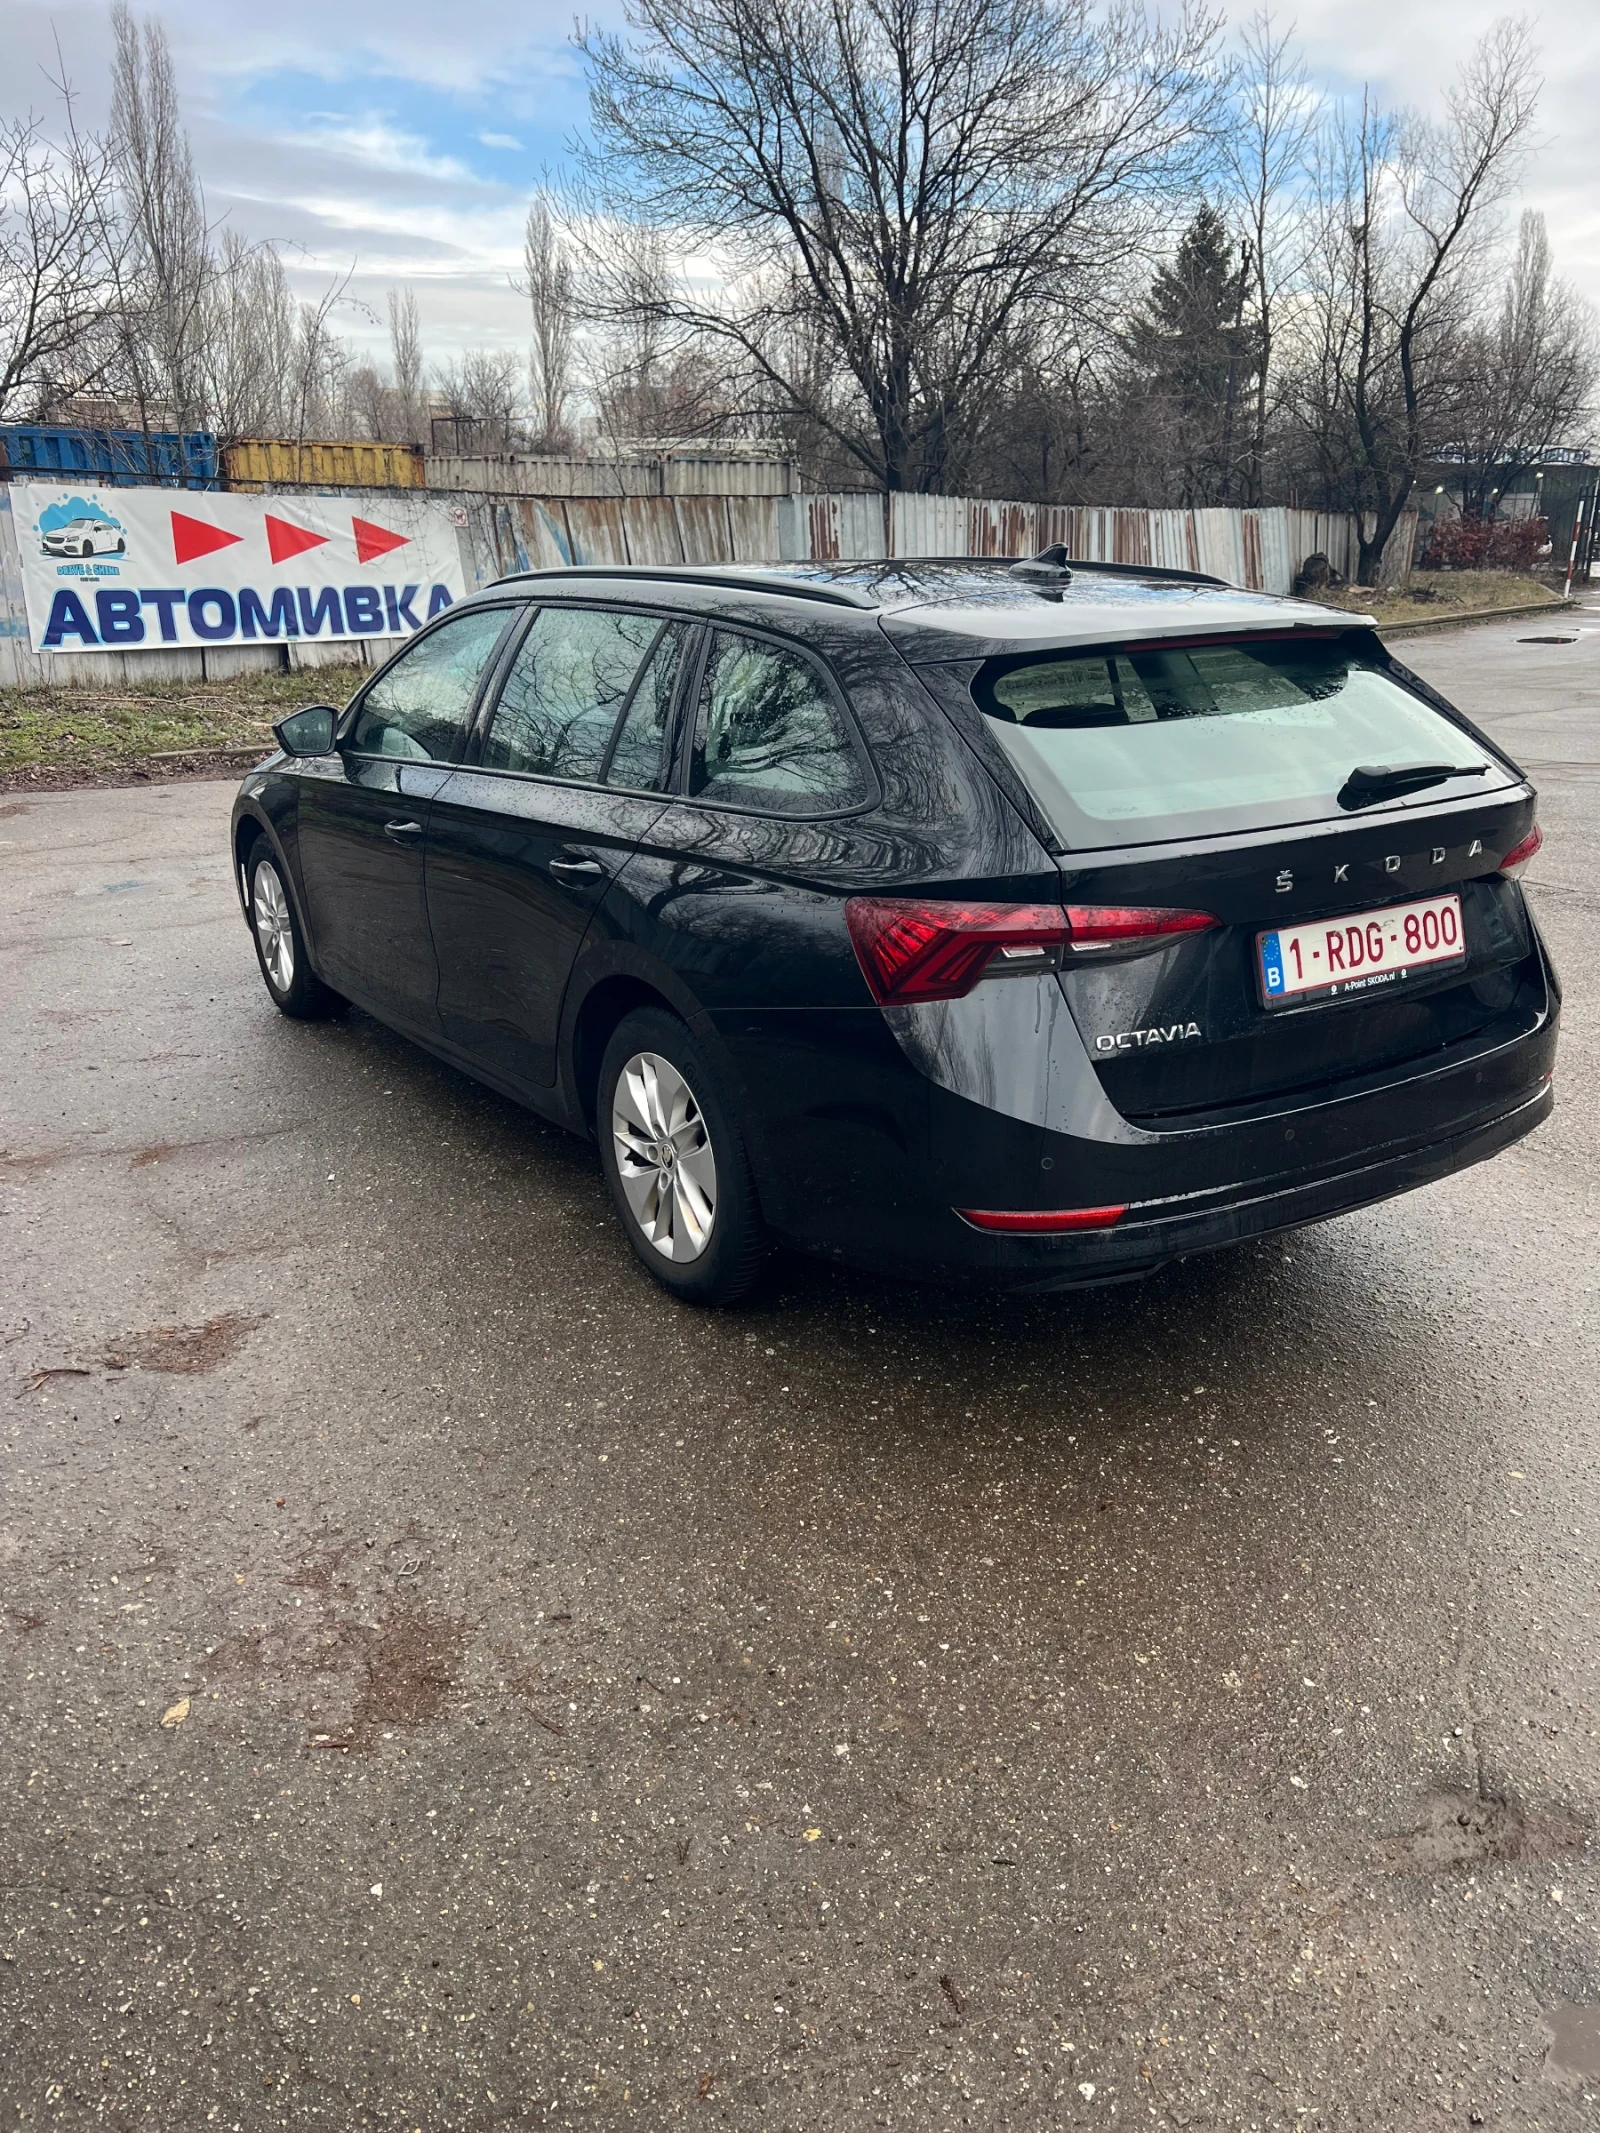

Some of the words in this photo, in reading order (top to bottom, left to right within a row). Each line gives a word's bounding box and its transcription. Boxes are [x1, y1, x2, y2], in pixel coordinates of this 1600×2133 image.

[57, 564, 84, 576] DRIVE
[85, 564, 92, 576] &
[93, 564, 120, 576] SHINE
[1275, 840, 1483, 893] ŠKODA
[1289, 906, 1457, 980] 1-RDG-800
[1267, 967, 1281, 987] B
[1344, 979, 1366, 992] A-Point
[1367, 971, 1396, 987] SKODA.nl
[1096, 1022, 1202, 1051] OCTAVIA
